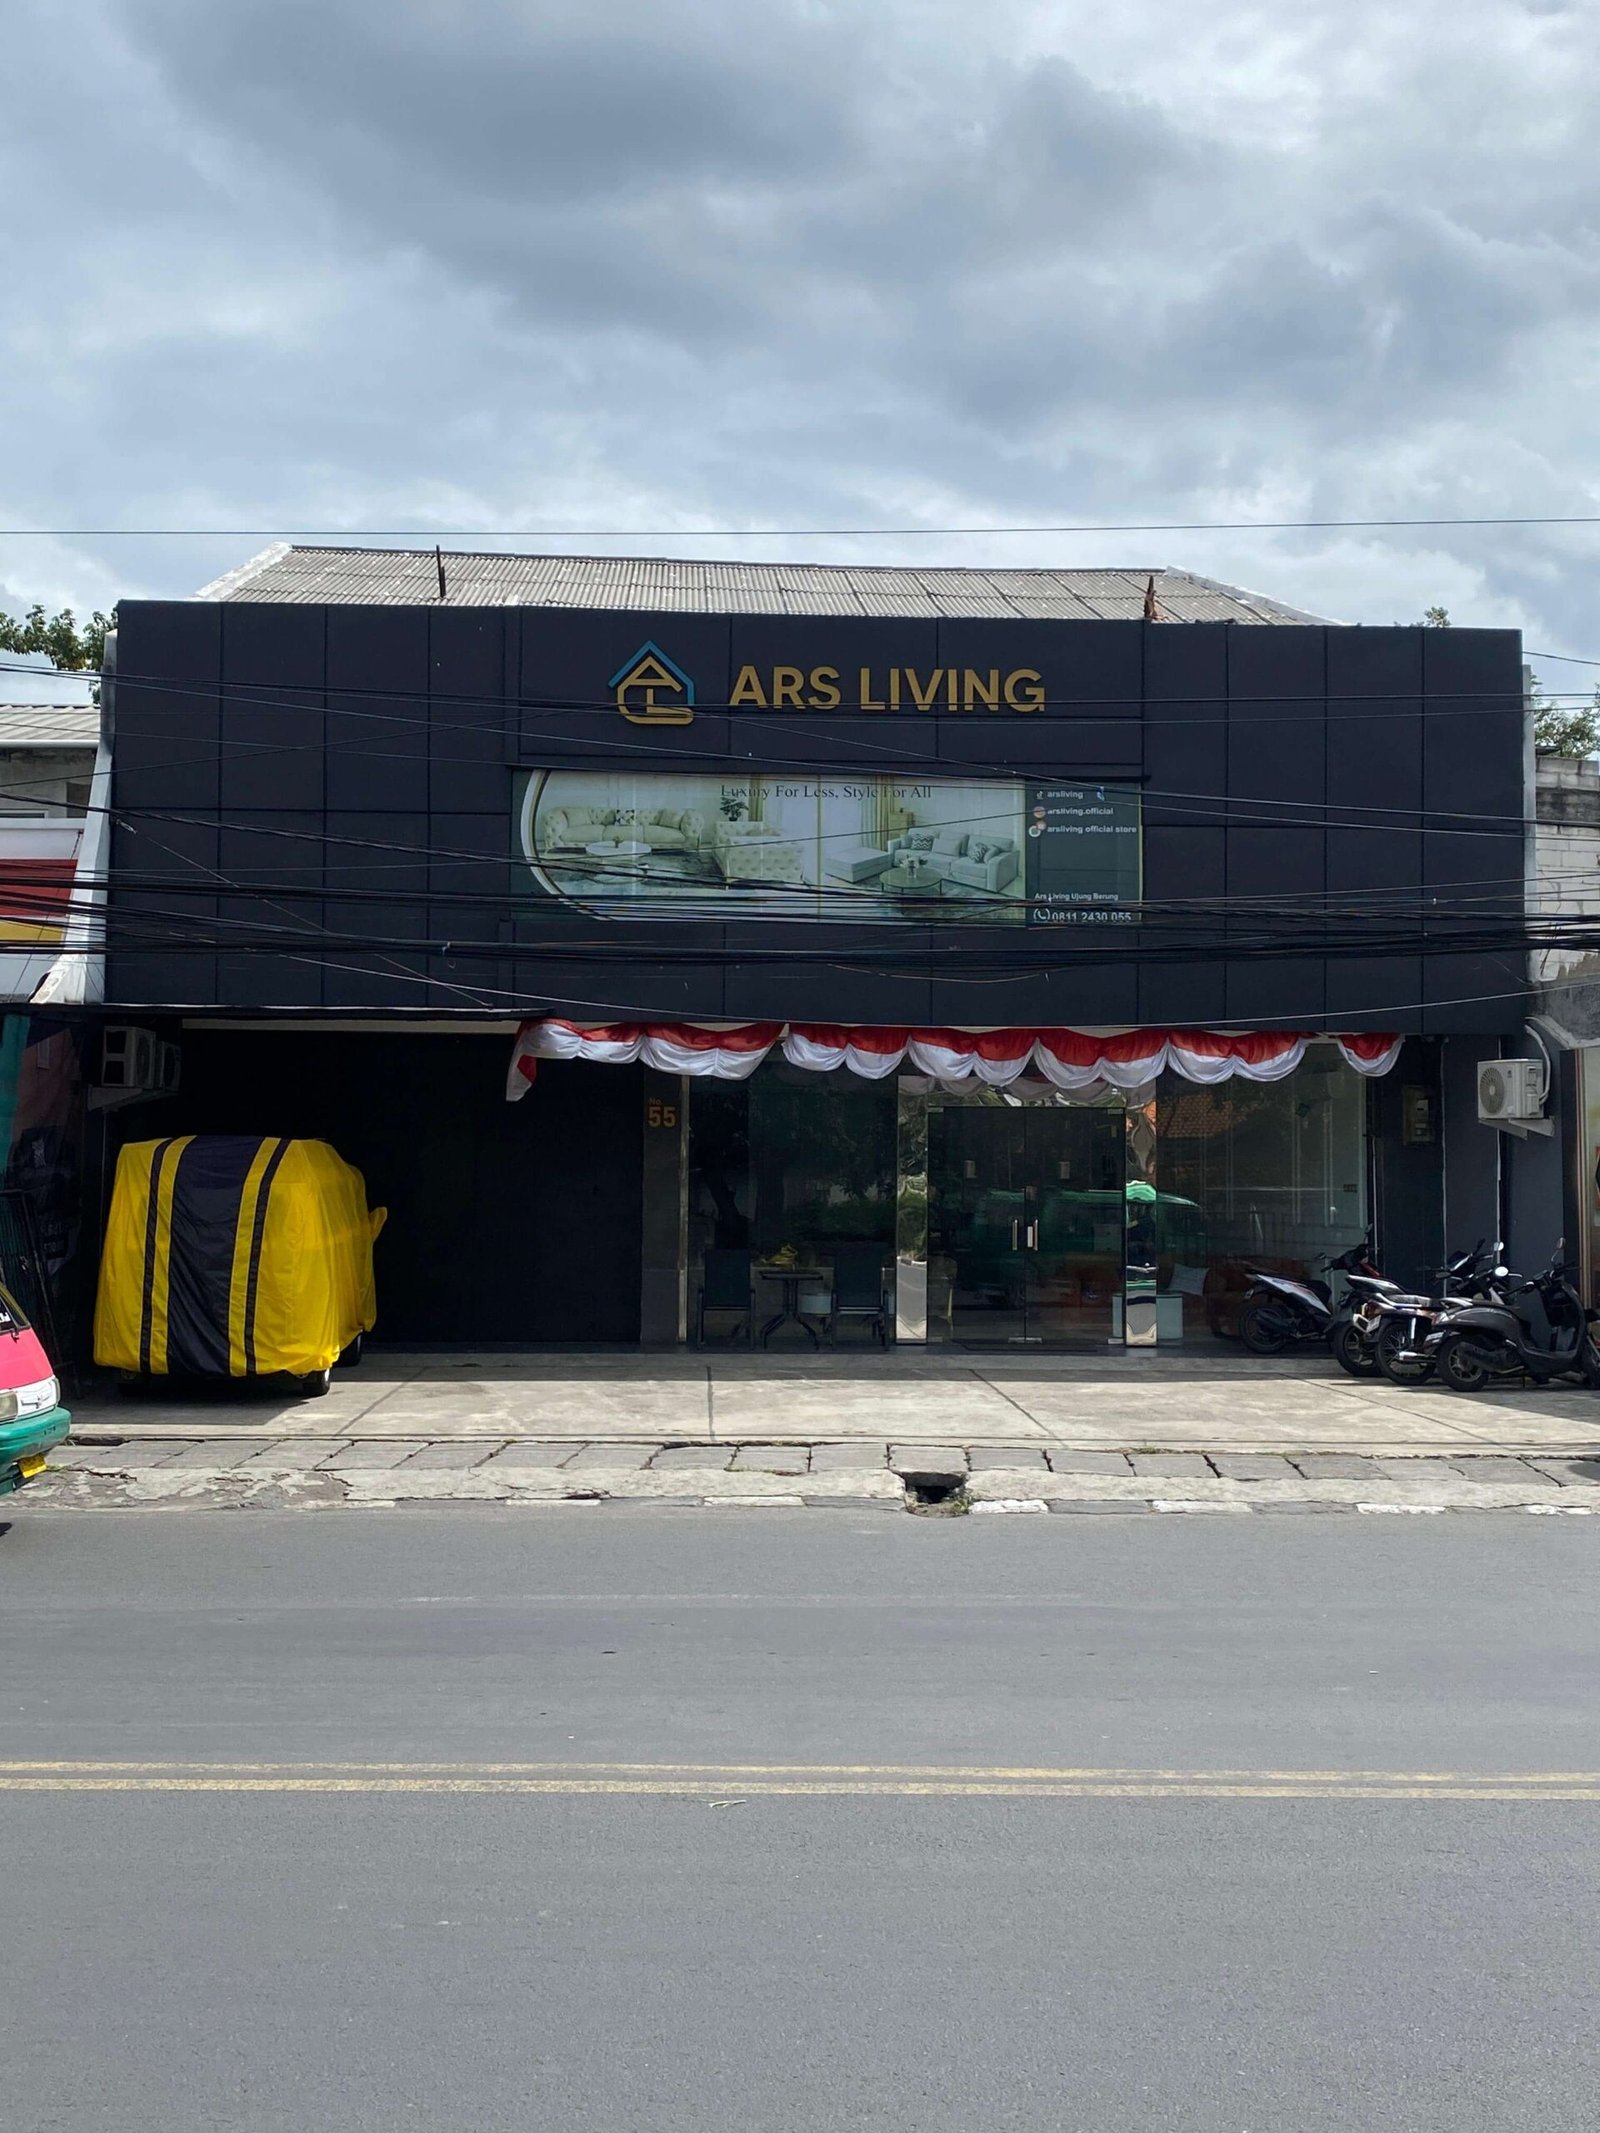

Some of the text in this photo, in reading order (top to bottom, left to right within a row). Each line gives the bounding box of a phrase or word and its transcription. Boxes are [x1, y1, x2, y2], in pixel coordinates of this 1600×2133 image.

[729, 665, 1046, 713] ARS LIVING
[720, 785, 768, 800] Luxury
[776, 785, 799, 798] For
[843, 786, 878, 801] Style
[884, 786, 907, 799] For
[910, 786, 932, 799] All
[1047, 791, 1084, 799] arsliving
[1047, 825, 1083, 834] arsliving
[1085, 825, 1113, 833] official
[648, 1106, 676, 1127] 55
